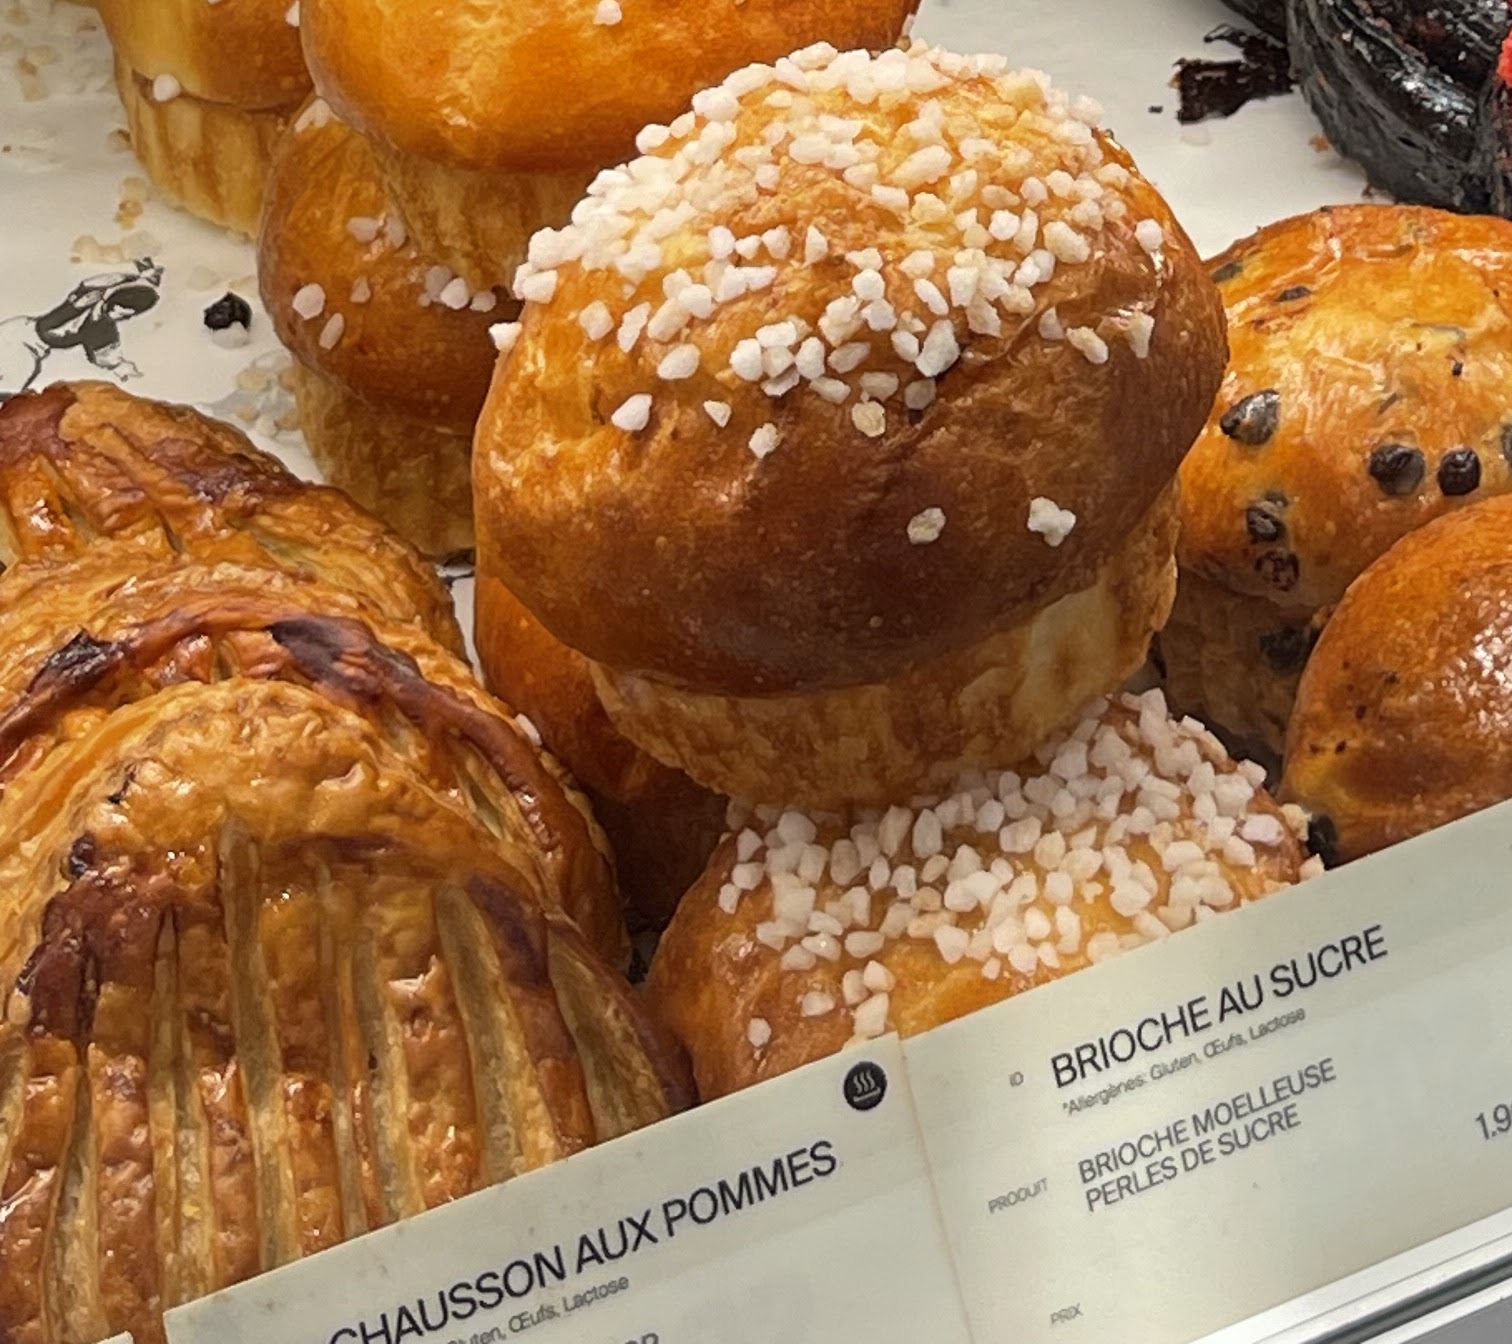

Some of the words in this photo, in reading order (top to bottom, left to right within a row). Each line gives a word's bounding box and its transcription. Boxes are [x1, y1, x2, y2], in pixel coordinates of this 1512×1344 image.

[1051, 996, 1212, 1089] BRIOCHE
[1218, 974, 1263, 1023] AU
[1271, 925, 1388, 998] SUCRE
[1150, 1053, 1202, 1082] Gluten,
[1249, 1008, 1306, 1041] Lactose
[1078, 1119, 1191, 1184] BRIOCHE
[1192, 1058, 1337, 1137] MOELLEUSE
[1085, 1155, 1179, 1212] PERLES
[1180, 1139, 1217, 1172] DE
[1217, 1103, 1301, 1155] SUCRE
[575, 1210, 658, 1275] AUX
[664, 1140, 837, 1238] POMMES
[988, 1178, 1049, 1213] PRODUIT
[562, 1275, 629, 1312] Lactose
[1050, 1303, 1082, 1325] PRIX
